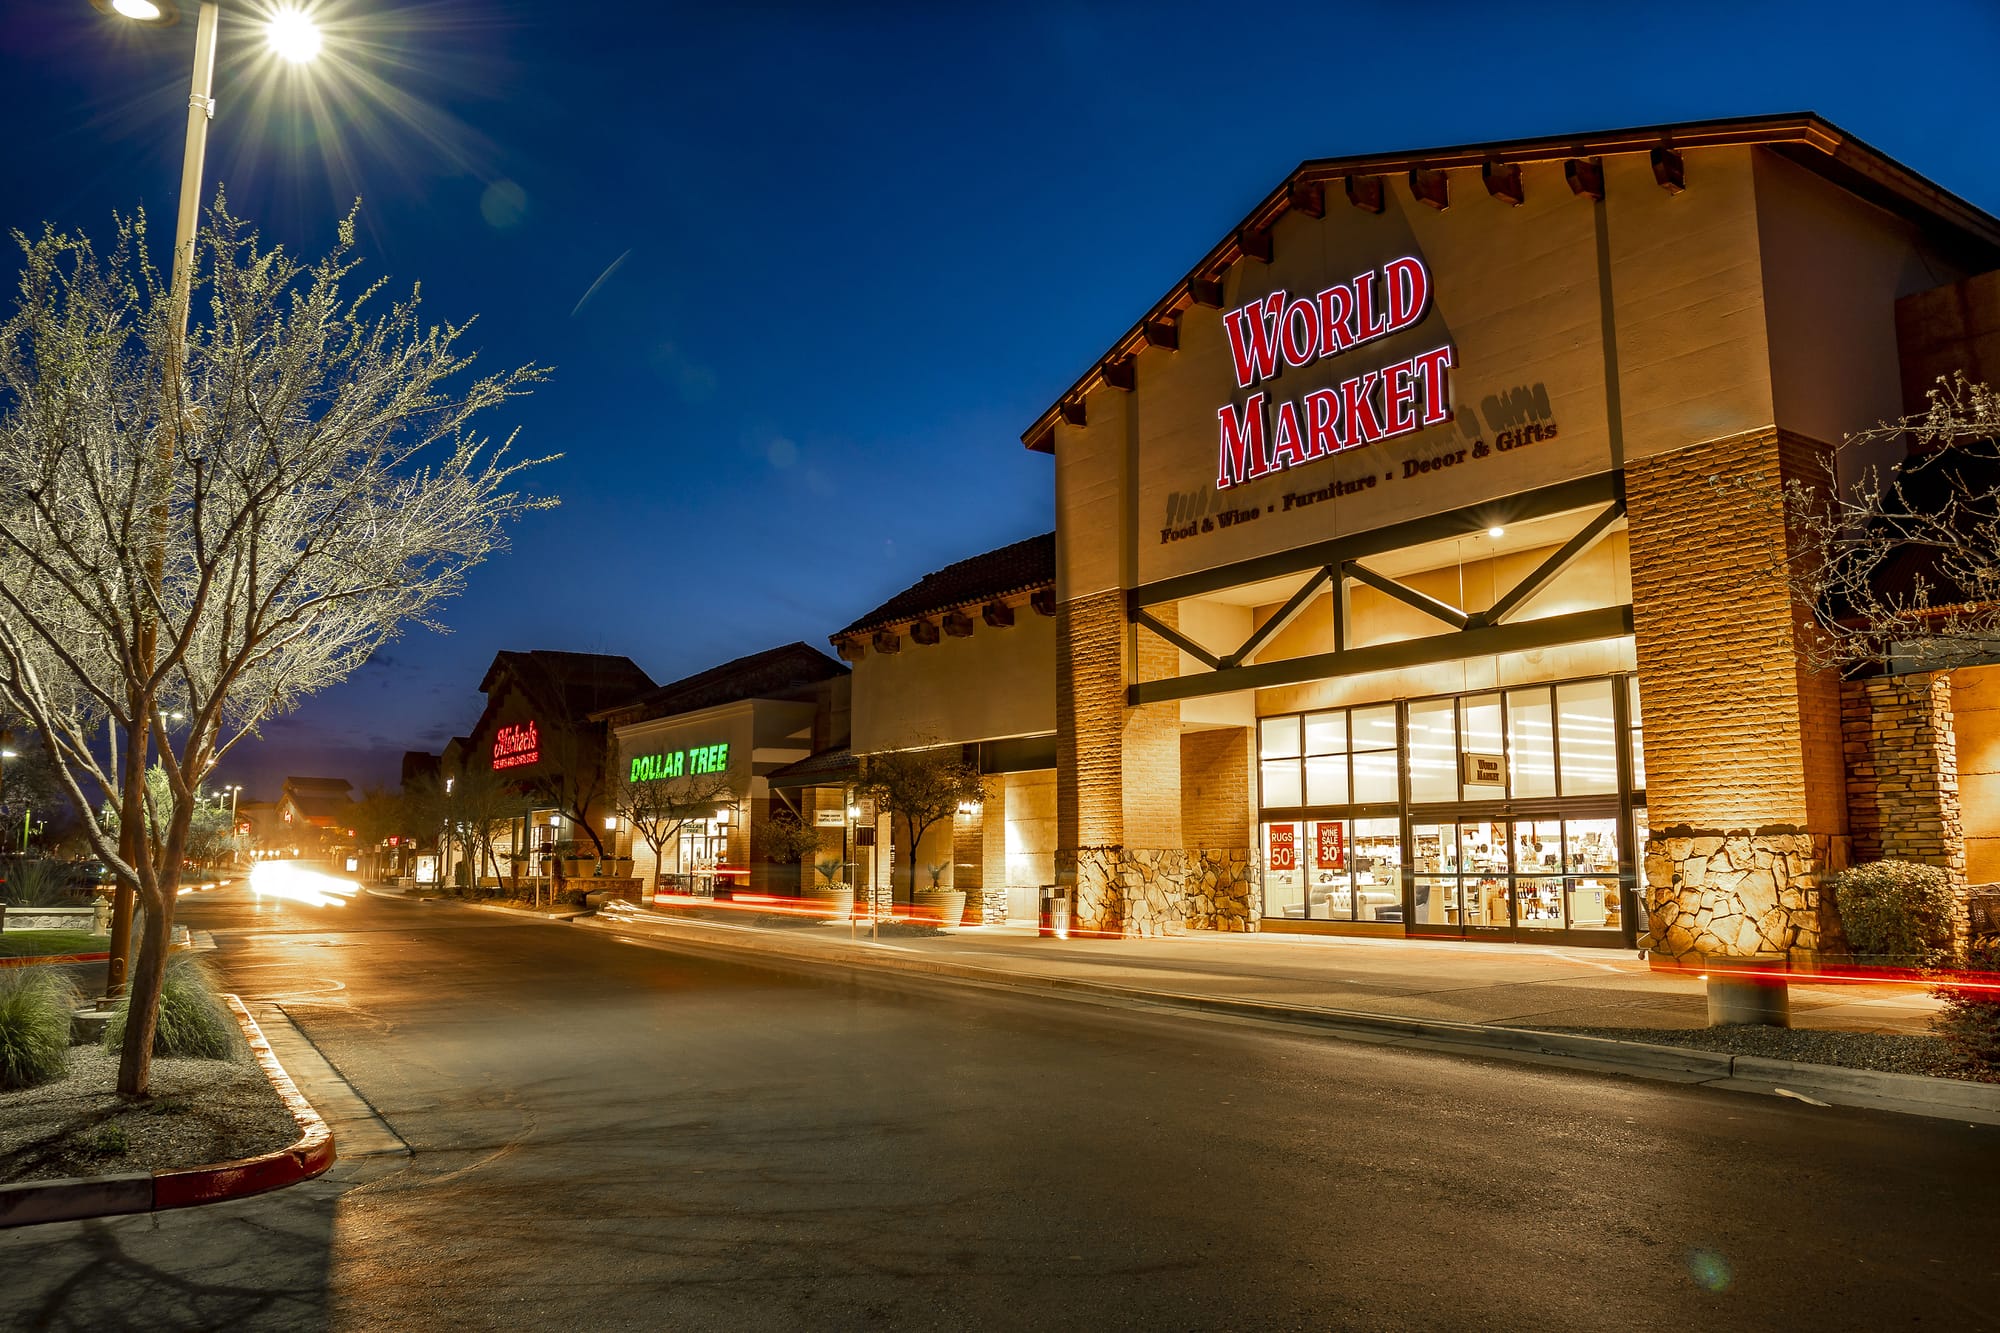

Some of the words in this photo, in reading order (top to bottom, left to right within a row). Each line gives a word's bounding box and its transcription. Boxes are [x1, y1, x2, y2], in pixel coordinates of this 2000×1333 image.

[1223, 256, 1428, 388] WORLD
[1217, 345, 1452, 490] MARKET
[1160, 521, 1198, 545] Food
[1201, 518, 1214, 533] &
[1217, 507, 1260, 529] Wine
[1282, 475, 1377, 512] Furniture
[1402, 450, 1467, 479] Decor
[1472, 440, 1490, 459] &
[1496, 423, 1558, 452] Gifts
[494, 720, 538, 759] Michaels
[630, 751, 685, 783] DOLLAR
[689, 743, 729, 775] TREE
[1271, 832, 1293, 842] RUGS
[1321, 828, 1339, 837] WINE
[1321, 836, 1339, 845] SALE
